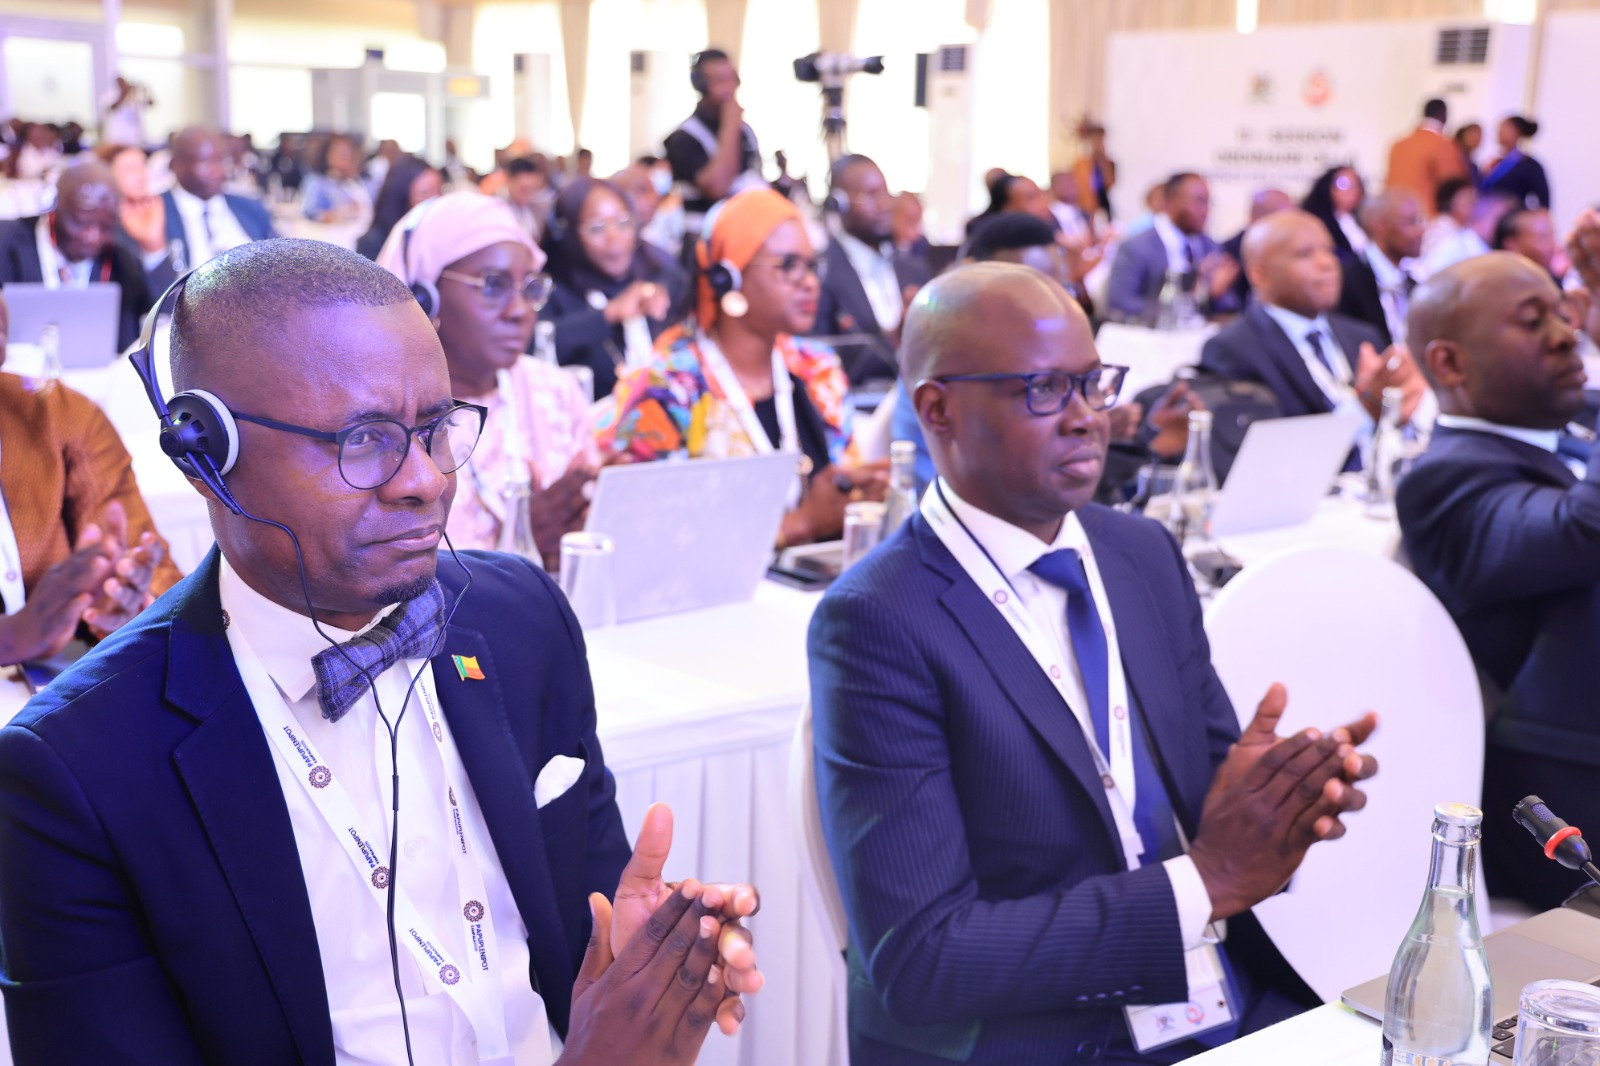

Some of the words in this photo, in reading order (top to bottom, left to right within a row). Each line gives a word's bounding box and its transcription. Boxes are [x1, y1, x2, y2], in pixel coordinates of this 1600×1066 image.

[283, 726, 313, 767] PAPUPLENIPOT
[348, 827, 376, 868] PAPUPLENIPOT
[409, 928, 442, 966] PAPUPLENIPOT
[476, 924, 489, 971] PAPUPLENIPOT
